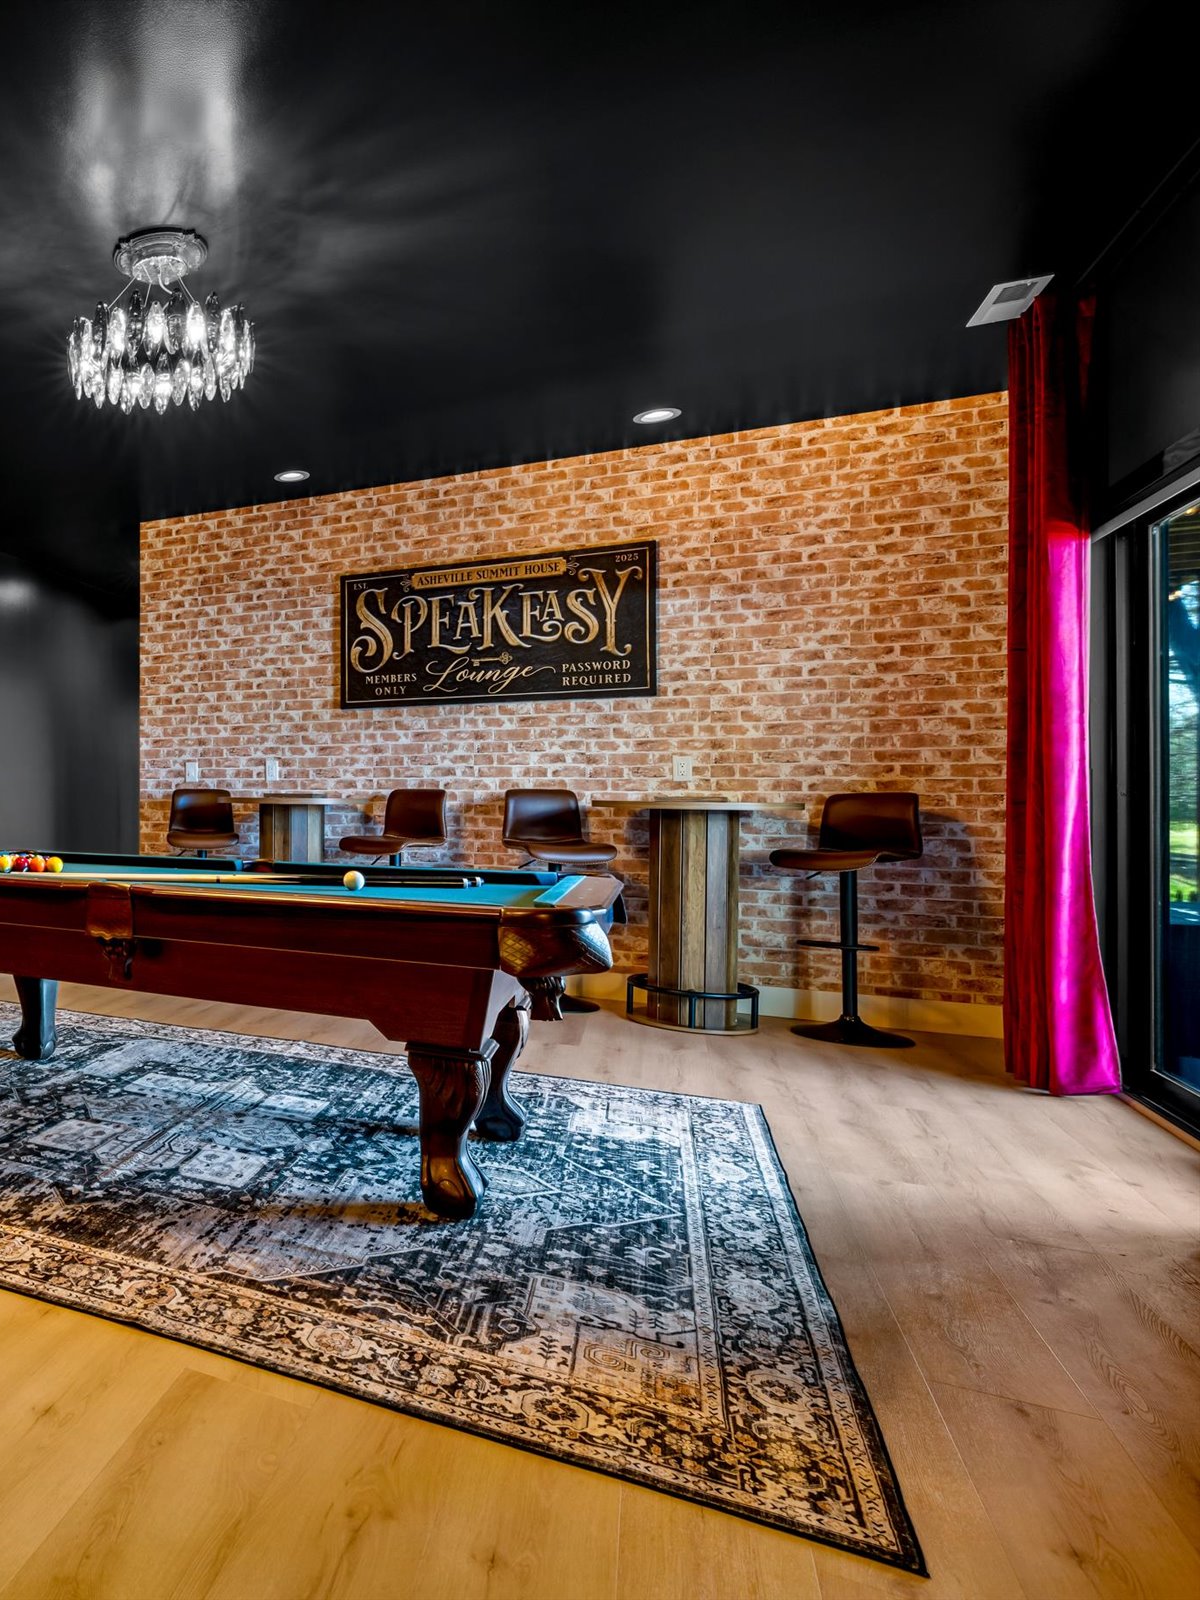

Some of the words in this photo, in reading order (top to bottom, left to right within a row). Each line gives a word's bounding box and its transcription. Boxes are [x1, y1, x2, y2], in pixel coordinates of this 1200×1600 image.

[615, 553, 639, 563] 2025
[417, 572, 473, 587] ASHEVILLE
[476, 567, 520, 580] SUMMIT
[524, 562, 560, 575] HOUSE
[353, 583, 368, 591] EST.
[350, 566, 643, 674] SPEAKEASY
[562, 660, 631, 673] PASSWORD
[365, 673, 417, 685] MEMBERS
[422, 656, 556, 694] Lounge
[562, 673, 632, 687] REQUIRED
[375, 686, 407, 696] ONLY
